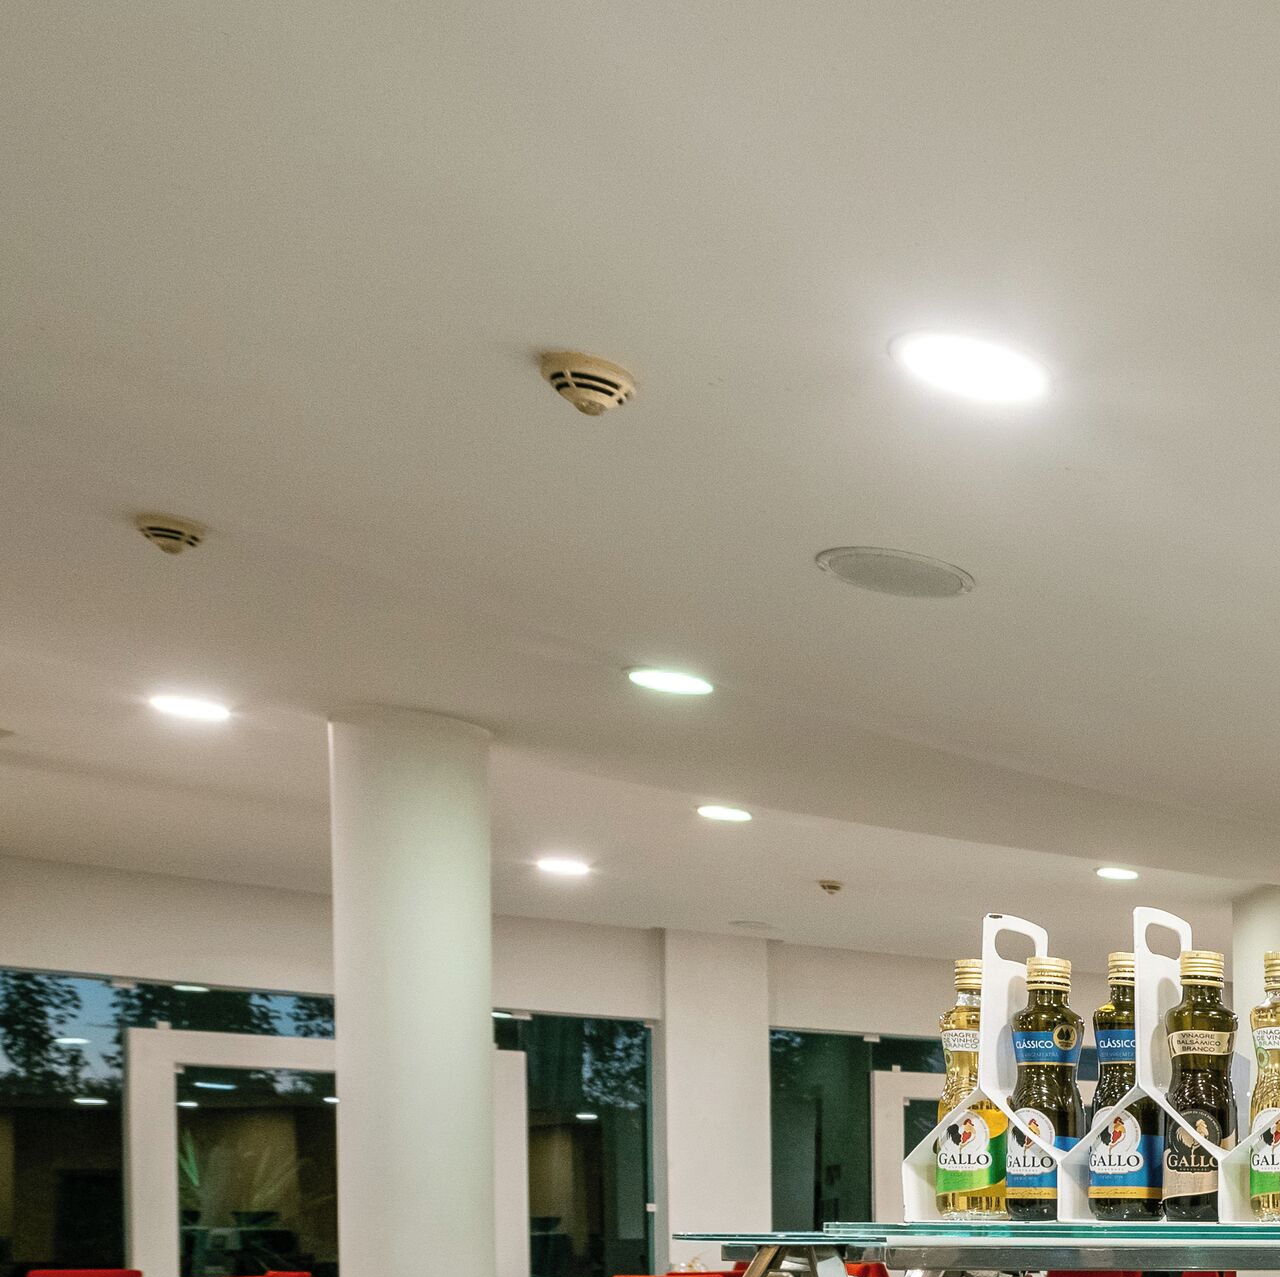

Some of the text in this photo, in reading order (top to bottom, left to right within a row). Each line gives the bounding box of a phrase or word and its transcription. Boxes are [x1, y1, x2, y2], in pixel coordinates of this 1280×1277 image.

[943, 1031, 977, 1039] VINAGRE
[952, 1036, 979, 1045] VINHO
[1181, 1032, 1215, 1040] VINAGRE
[1015, 1037, 1053, 1049] CLÁSSICO
[1177, 1038, 1221, 1046] BALSÂMICO
[938, 1153, 990, 1166] GALLO
[1006, 1155, 1054, 1168] GALLO
[1090, 1154, 1140, 1167] GALLO
[1252, 1153, 1280, 1168] GAL
